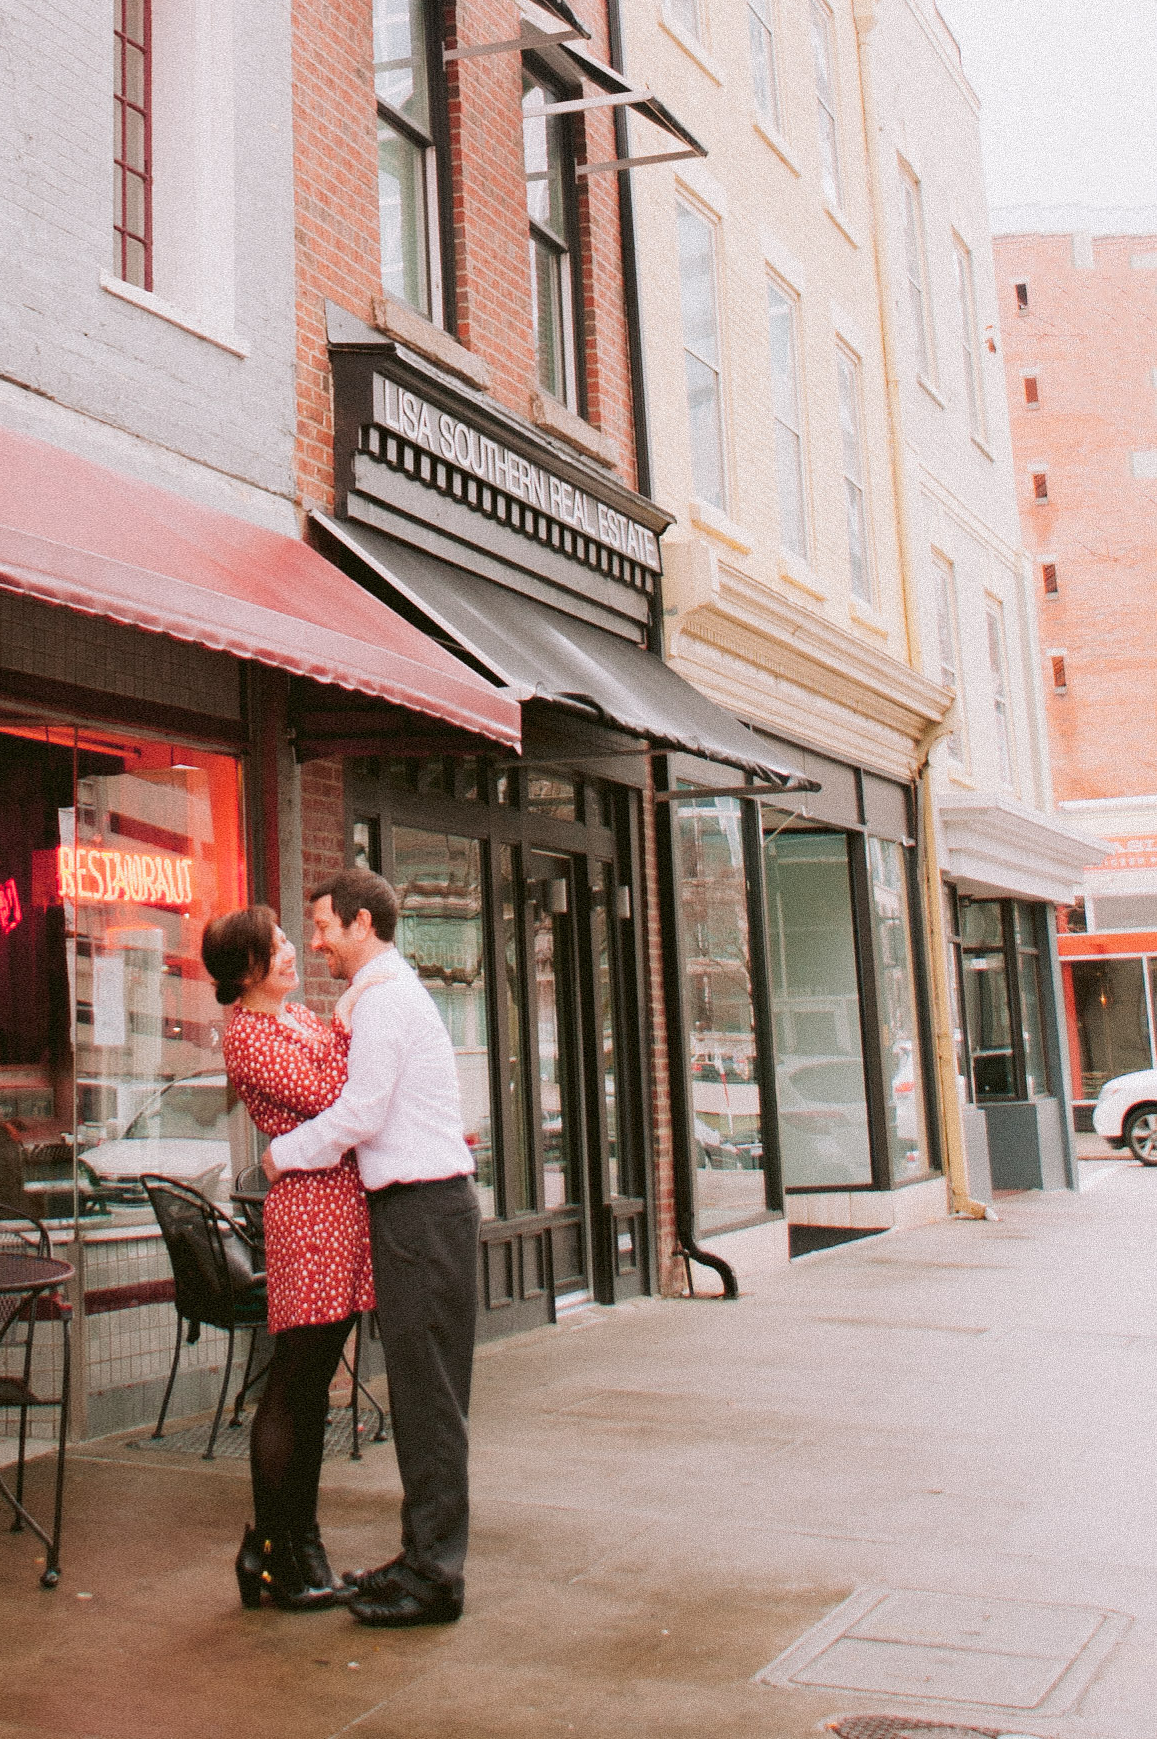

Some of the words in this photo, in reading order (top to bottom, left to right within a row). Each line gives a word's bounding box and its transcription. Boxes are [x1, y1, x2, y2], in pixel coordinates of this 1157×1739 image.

[383, 378, 435, 452] LISA
[438, 412, 547, 510] SOUTHERN
[548, 474, 597, 536] REAL
[597, 501, 659, 567] ESTATE
[57, 845, 193, 904] RESTAURANT
